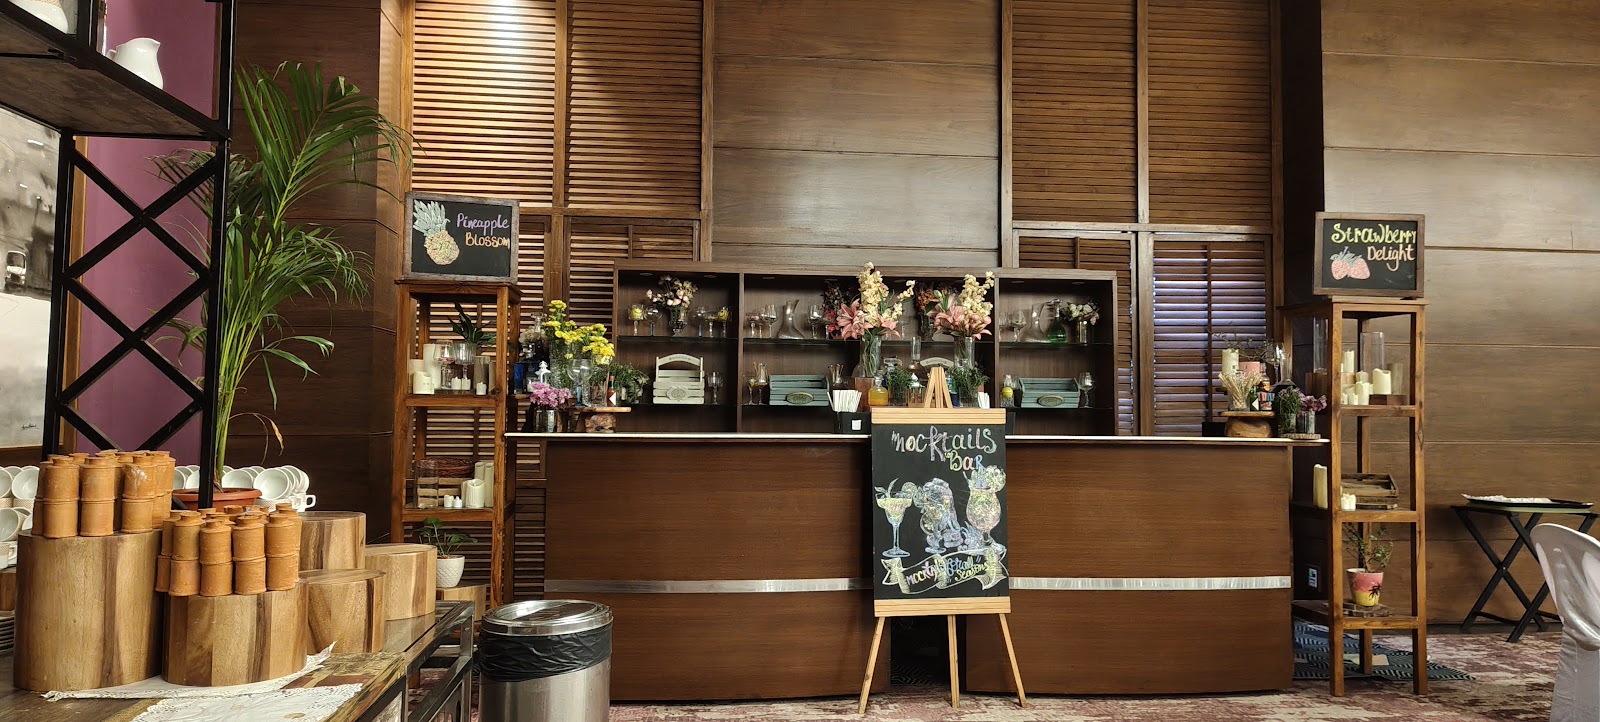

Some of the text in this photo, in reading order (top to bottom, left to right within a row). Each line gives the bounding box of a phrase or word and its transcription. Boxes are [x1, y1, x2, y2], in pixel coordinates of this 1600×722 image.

[457, 213, 510, 236] Pineapple
[1331, 223, 1416, 243] Strawberry
[465, 232, 511, 249] Blossom
[1367, 244, 1415, 272] Delight
